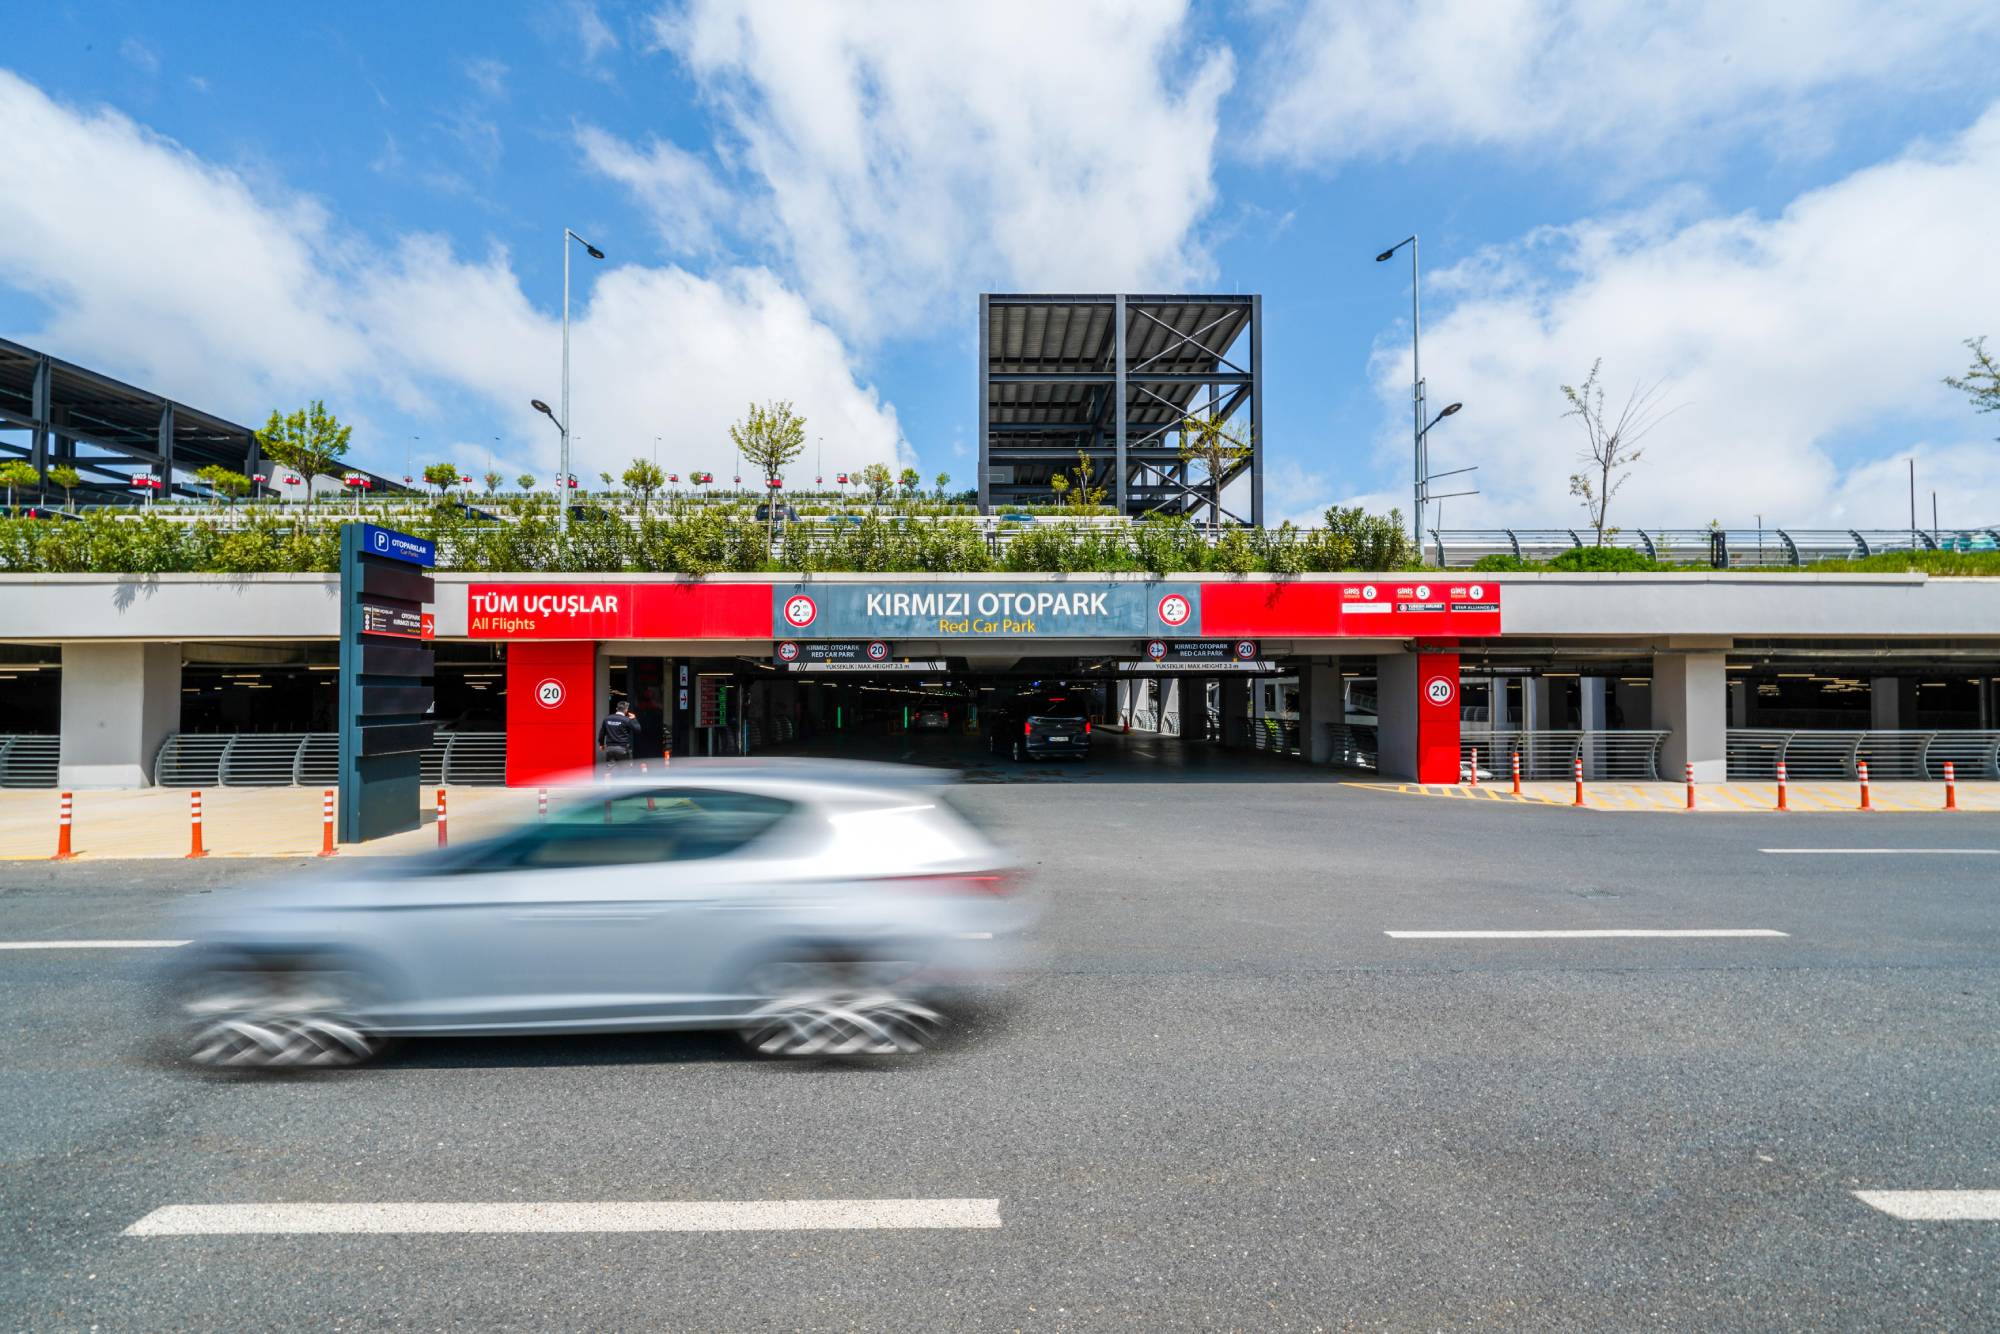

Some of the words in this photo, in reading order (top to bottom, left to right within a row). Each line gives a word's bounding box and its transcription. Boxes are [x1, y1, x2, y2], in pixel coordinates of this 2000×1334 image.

[378, 534, 385, 547] P
[391, 539, 427, 554] OTOPARKLAR
[1366, 588, 1373, 598] 6
[1419, 588, 1426, 597] 5
[1473, 588, 1480, 597] 4
[472, 592, 518, 613] TÜM
[523, 595, 618, 617] UÇUŞLAR
[867, 593, 970, 616] KIRMIZI
[977, 593, 1108, 616] OTOPARK
[471, 617, 489, 630] All
[492, 617, 535, 633] Flights
[939, 619, 969, 633] Red
[973, 619, 998, 633] Car
[1003, 619, 1036, 633] Park
[872, 646, 885, 655] 20
[1240, 644, 1251, 653] 20
[543, 687, 559, 699] 20
[1432, 685, 1448, 697] 20
